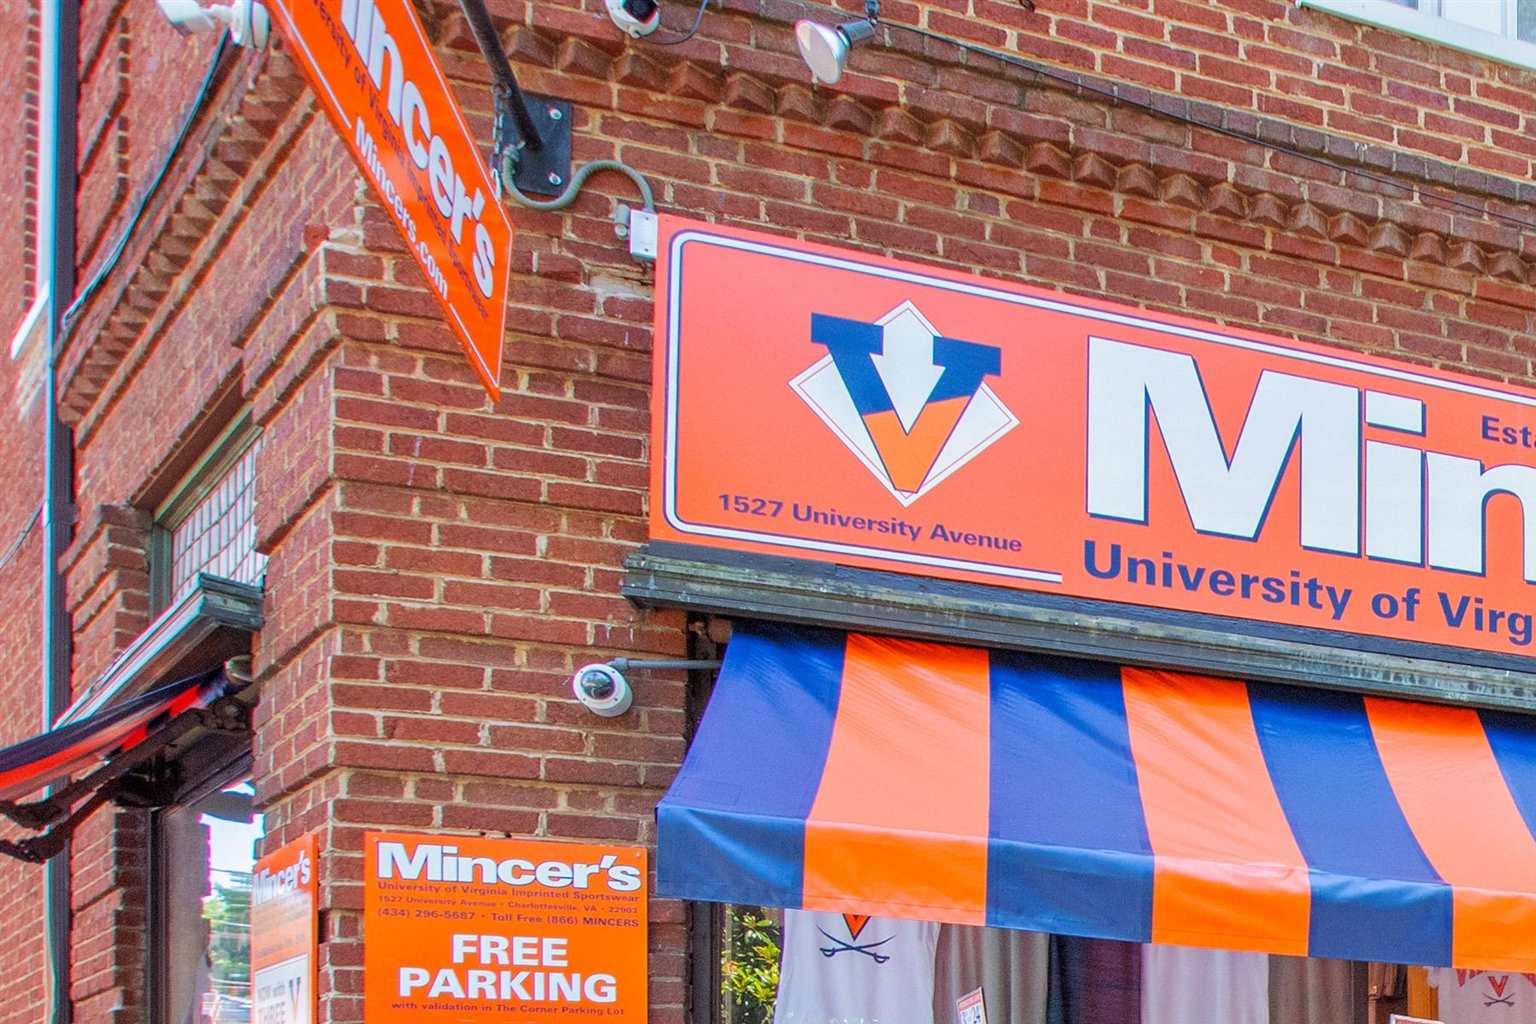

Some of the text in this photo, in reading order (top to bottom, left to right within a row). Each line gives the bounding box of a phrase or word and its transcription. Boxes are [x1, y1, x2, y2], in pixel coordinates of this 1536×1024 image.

[355, 116, 448, 300] Mincers.com
[718, 494, 1023, 553] 1527 University Avenue
[1082, 540, 1353, 622] University
[1370, 587, 1420, 623] of
[253, 850, 310, 902] Mincer's
[377, 841, 641, 892] Mincer's
[378, 882, 640, 903] University of Virginia Imprinted Sportswear
[406, 896, 457, 906] University
[377, 907, 640, 927] (434) 296-5687 Toll Free (866) MINCERS
[450, 933, 569, 968] FREE
[398, 967, 618, 1004] PARKING
[391, 1002, 418, 1010] with
[421, 1003, 478, 1011] validation
[496, 1004, 516, 1012] The
[520, 1005, 558, 1014] Corner
[561, 1007, 604, 1016] Parking
